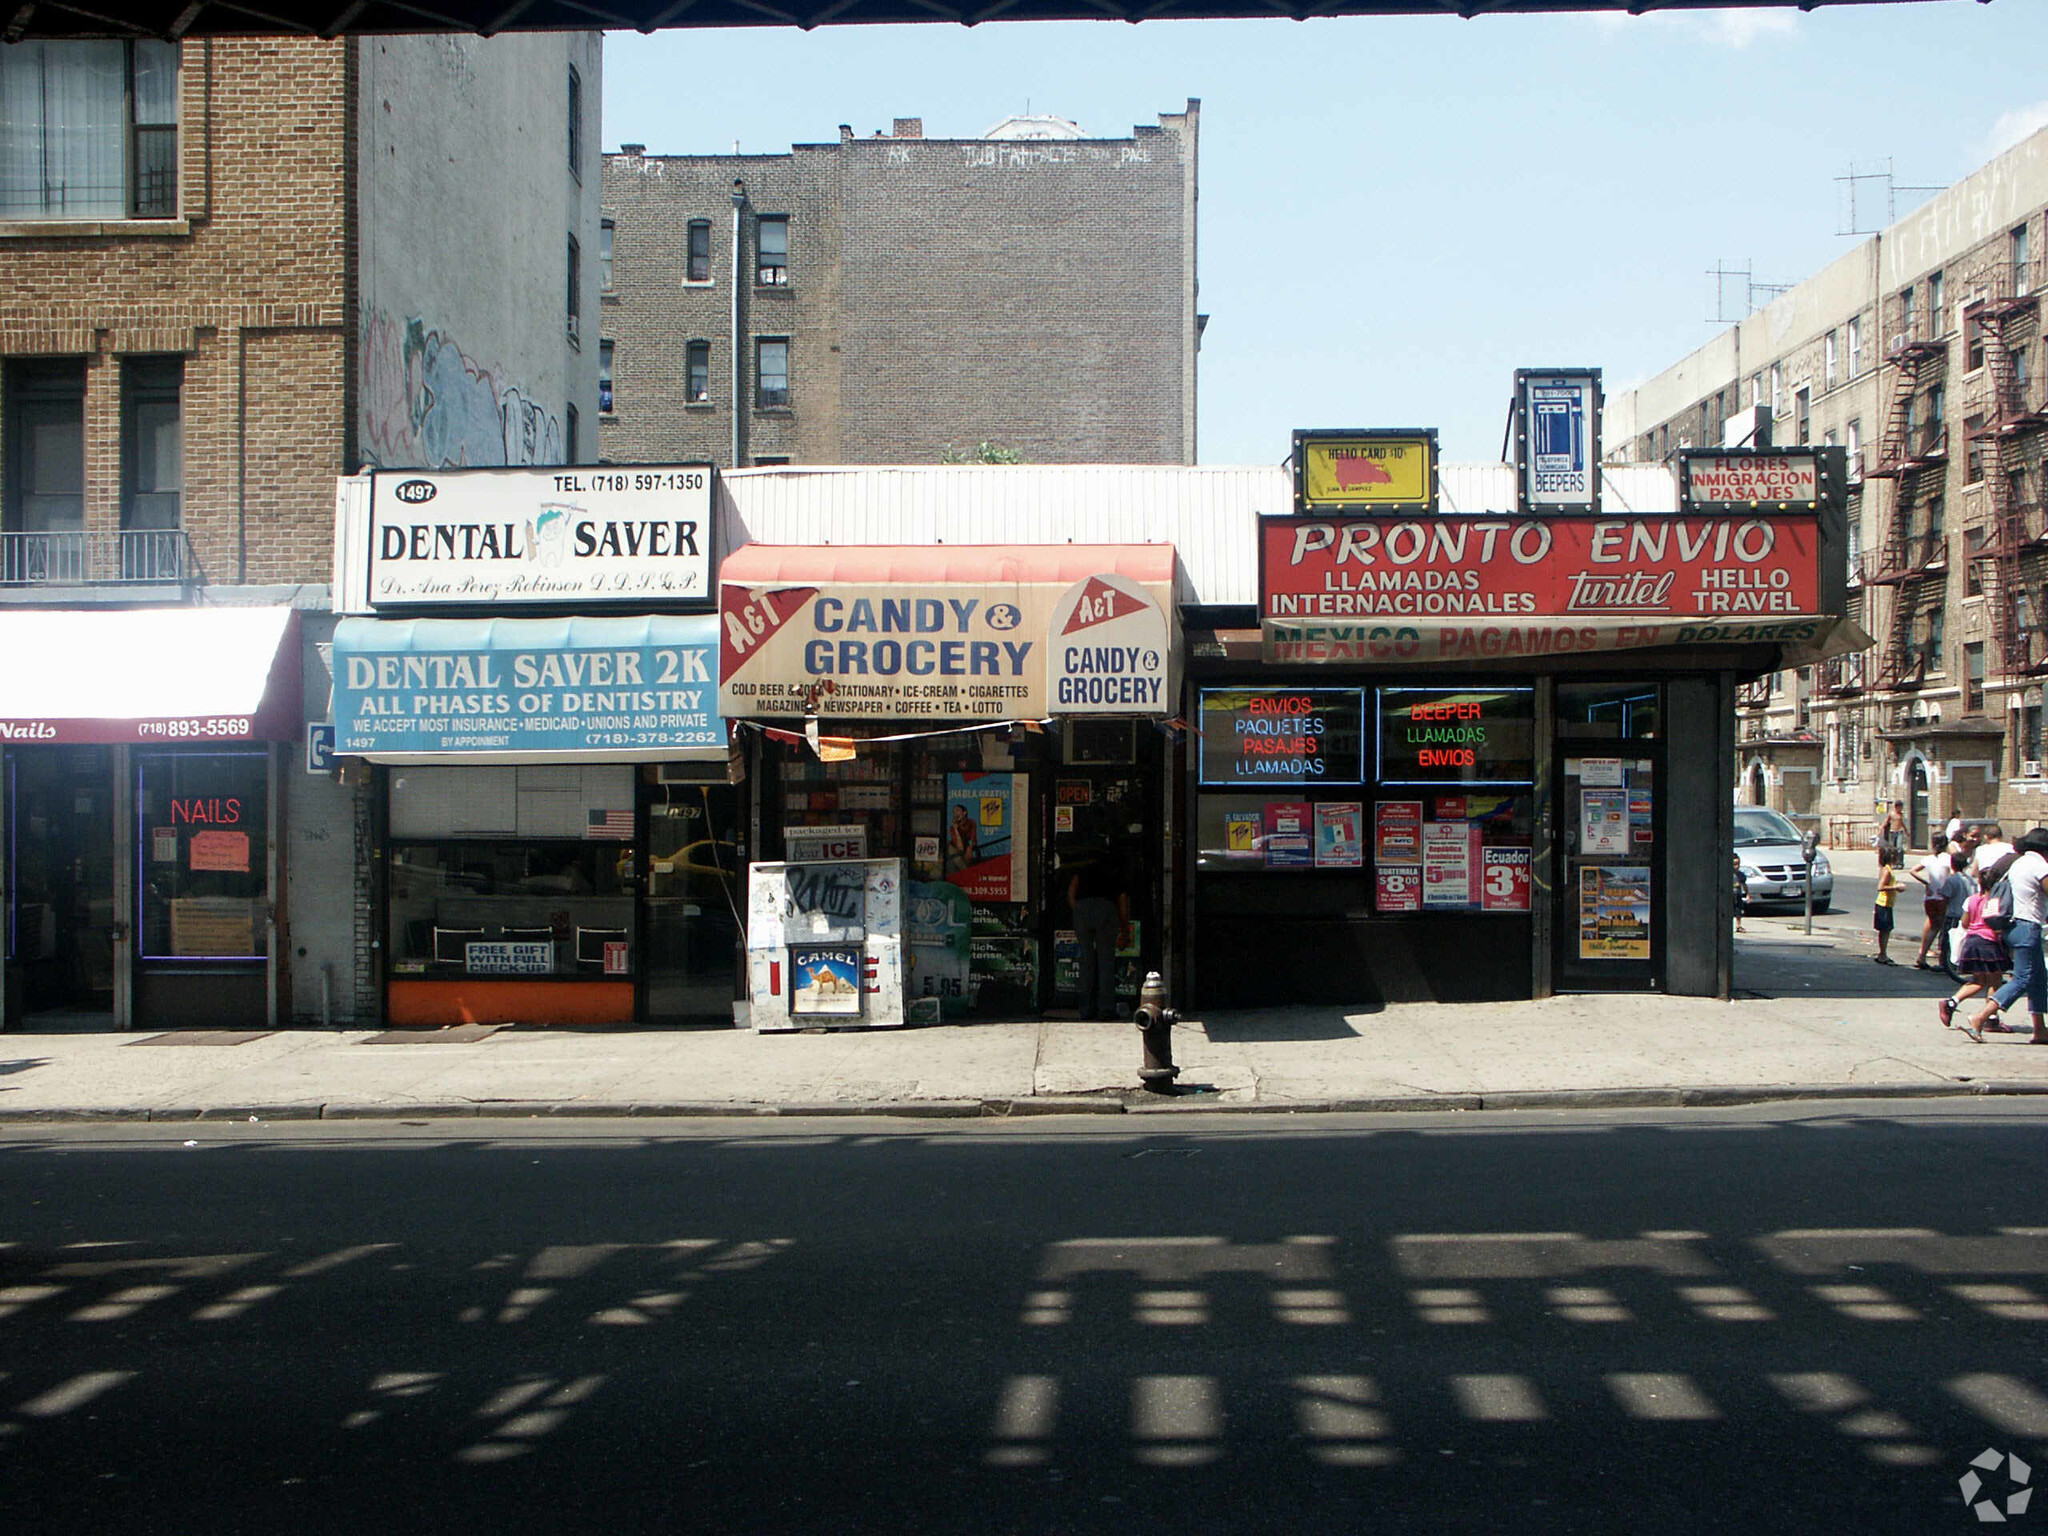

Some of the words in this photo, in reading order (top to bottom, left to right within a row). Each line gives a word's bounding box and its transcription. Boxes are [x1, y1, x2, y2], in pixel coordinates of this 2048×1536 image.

[1328, 447, 1357, 460] HELLO
[1361, 447, 1387, 460] CARD
[1714, 457, 1790, 472] FLORES
[554, 476, 587, 492] TEL.
[591, 475, 629, 492] (718)
[635, 474, 703, 491] 597-1350
[1535, 473, 1585, 493] BEEPERS
[1690, 472, 1813, 486] INMIGRACION
[1709, 487, 1794, 500] PASAJES
[380, 523, 525, 561] DENTAL
[574, 520, 700, 558] SAVER
[1290, 521, 1553, 566] PRONTO
[1590, 517, 1776, 563] ENVIO
[380, 575, 407, 595] Dr.
[411, 576, 451, 594] Ana
[456, 575, 502, 601] Perez
[505, 572, 583, 594] Robinson
[1324, 569, 1480, 592] LLAMADAS
[1701, 568, 1791, 589] HELLO
[1078, 589, 1116, 625] A&T
[1271, 592, 1537, 614] INTERNACIONALES
[1692, 591, 1800, 612] TRAVEL
[724, 587, 780, 654] A&T
[813, 597, 980, 634] CANDY
[988, 603, 1017, 631] &
[1273, 625, 1421, 659] MEXICO
[1438, 625, 1598, 657] PAGAMOS
[1614, 627, 1661, 648] EN
[1675, 621, 1819, 644] DOLARES
[804, 639, 1034, 676] GROCERY
[1064, 647, 1140, 674] CANDY
[346, 654, 501, 690] DENTAL
[513, 652, 644, 688] SAVER
[655, 649, 711, 684] 2K
[731, 683, 757, 696] COLD
[759, 684, 784, 697] BEER
[834, 684, 894, 698] STATIONARY
[902, 685, 958, 698] ICE-CREAM
[968, 685, 1029, 698] CIGARETTES
[1058, 677, 1163, 704] GROCERY
[359, 695, 405, 716] ALL
[413, 694, 511, 715] PHASES
[518, 693, 553, 714] OF
[562, 690, 703, 712] DENTISTRY
[823, 701, 883, 714] NEWSPAPER
[895, 701, 932, 714] COFFEE
[943, 701, 962, 714] TEA
[972, 701, 1003, 714] LOTTO
[1250, 696, 1313, 715] ENVIOS
[1411, 702, 1482, 721] BEEPER
[167, 718, 250, 737] 893-5569
[353, 719, 372, 733] WE
[373, 719, 417, 732] ACCEPT
[419, 718, 449, 732] MOST
[452, 717, 518, 732] INSURANCE
[525, 716, 580, 731] MEDICAID
[587, 715, 630, 729] UNIONS
[633, 715, 658, 729] AND
[660, 713, 708, 728] PRIVATE
[1235, 717, 1325, 735] PAQUETES
[345, 737, 376, 749] 1497
[440, 736, 454, 747] BY
[1407, 727, 1486, 743] LLAMADAS
[1243, 736, 1318, 755] PASAJES
[1235, 758, 1325, 775] LLAMADAS
[1418, 749, 1475, 766] ENVIOS
[1058, 786, 1089, 801] OPEN
[171, 798, 241, 824] NAILS
[789, 826, 845, 836] packaged
[846, 826, 861, 834] ice
[822, 841, 860, 858] ICE
[1485, 849, 1530, 864] Ecuador
[1426, 865, 1444, 884] 5
[469, 945, 507, 954] FREE
[513, 945, 548, 954] GIFT
[797, 951, 856, 966] CAMEL
[469, 955, 512, 964] WITH
[513, 955, 548, 964] FULL
[469, 964, 547, 973] CHECK-UP
